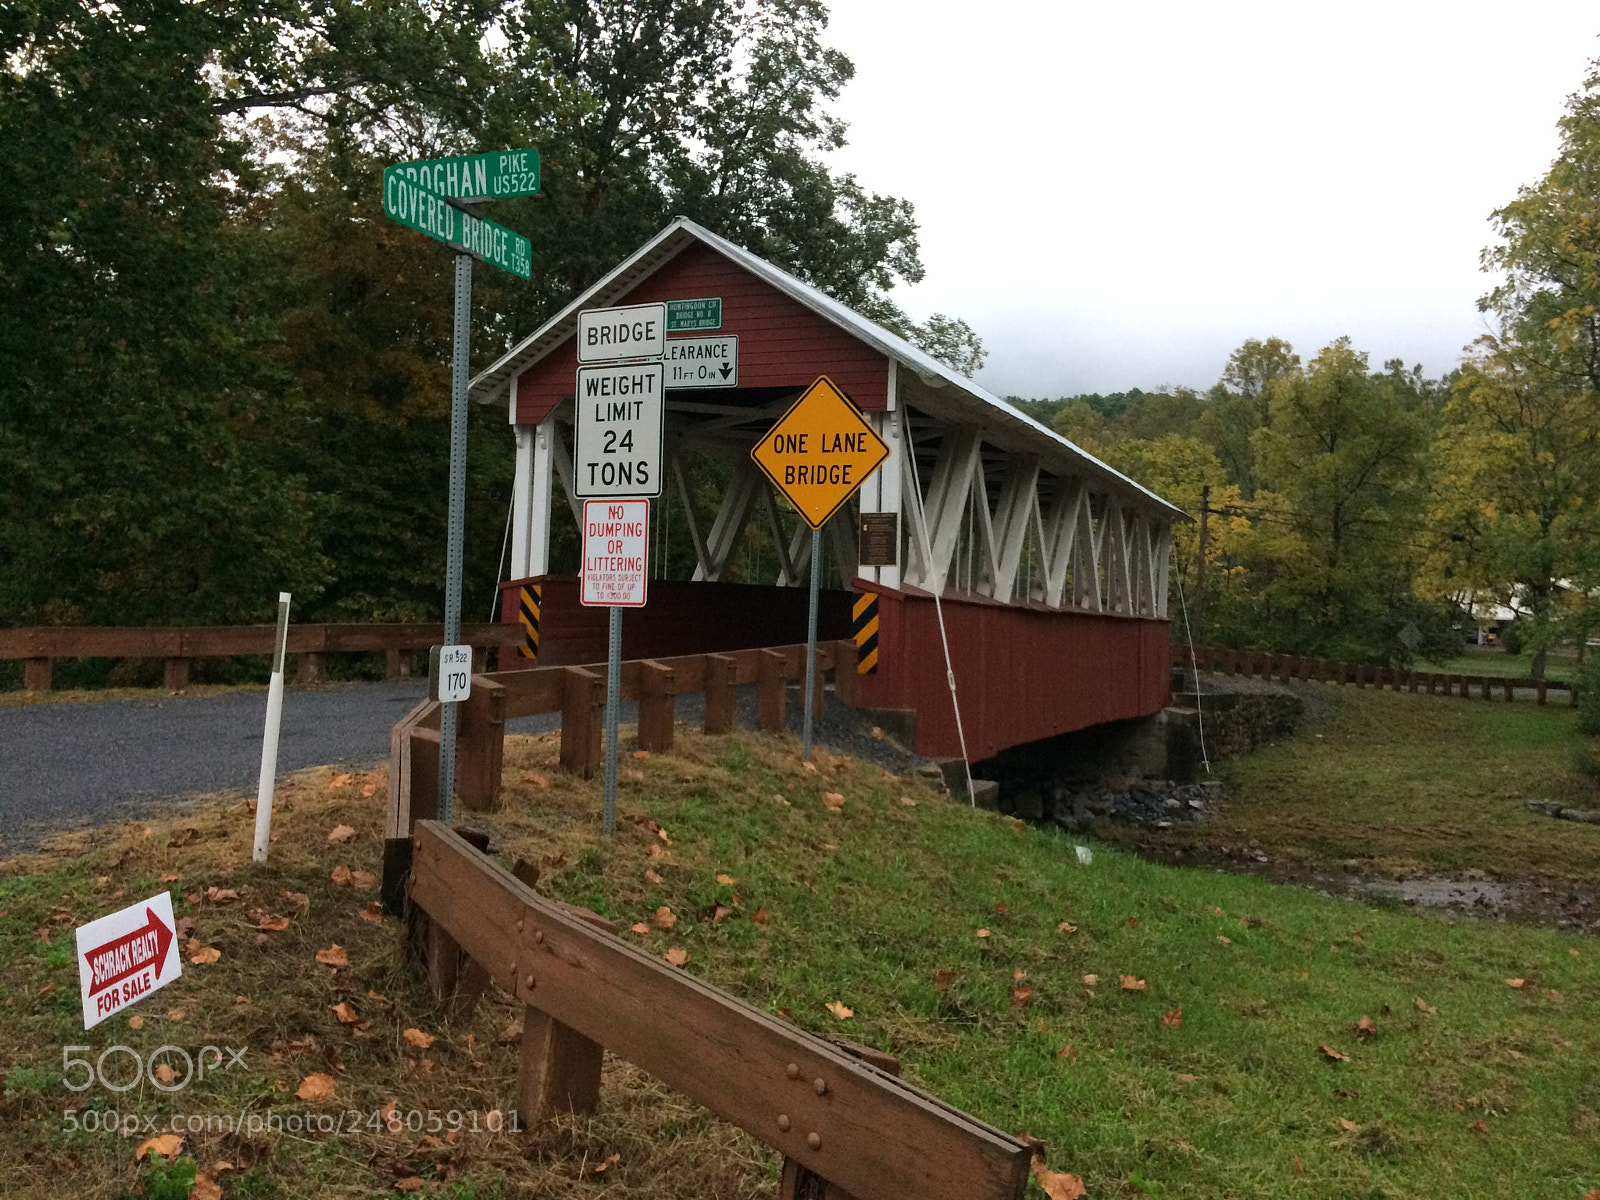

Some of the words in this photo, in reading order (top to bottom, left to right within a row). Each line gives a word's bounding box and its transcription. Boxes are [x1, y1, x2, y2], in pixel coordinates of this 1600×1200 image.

[500, 153, 528, 174] PIKE
[493, 172, 536, 195] US522
[388, 174, 454, 241] COVERED
[462, 213, 509, 266] BRIDGE
[515, 237, 526, 257] RD
[511, 253, 530, 277] T358
[676, 311, 694, 320] BRIDGE
[587, 321, 656, 346] BRIDGE
[656, 344, 728, 361] LEARANCE
[586, 374, 656, 397] WEIGHT
[595, 401, 644, 422] LIMIT
[603, 429, 634, 453] 24
[774, 433, 808, 454] ONE
[822, 432, 867, 453] LANE
[587, 461, 649, 486] TONS
[785, 465, 852, 485] BRIDGE
[608, 505, 625, 520] NO
[589, 522, 643, 538] DUMPING
[607, 540, 623, 554] OR
[587, 557, 642, 572] LITTERING
[587, 573, 616, 582] VIOLATORS
[618, 574, 642, 582] SUBJECT
[602, 583, 616, 591] FINE
[618, 583, 625, 591] OF
[627, 583, 636, 591] UP
[597, 591, 604, 600] TO
[444, 654, 454, 664] SR
[455, 653, 467, 663] 522
[448, 672, 467, 691] 170
[93, 942, 132, 985] SCHRACK
[131, 929, 160, 966] REALTY
[97, 988, 120, 1017] FOR
[122, 972, 152, 1003] SALE
